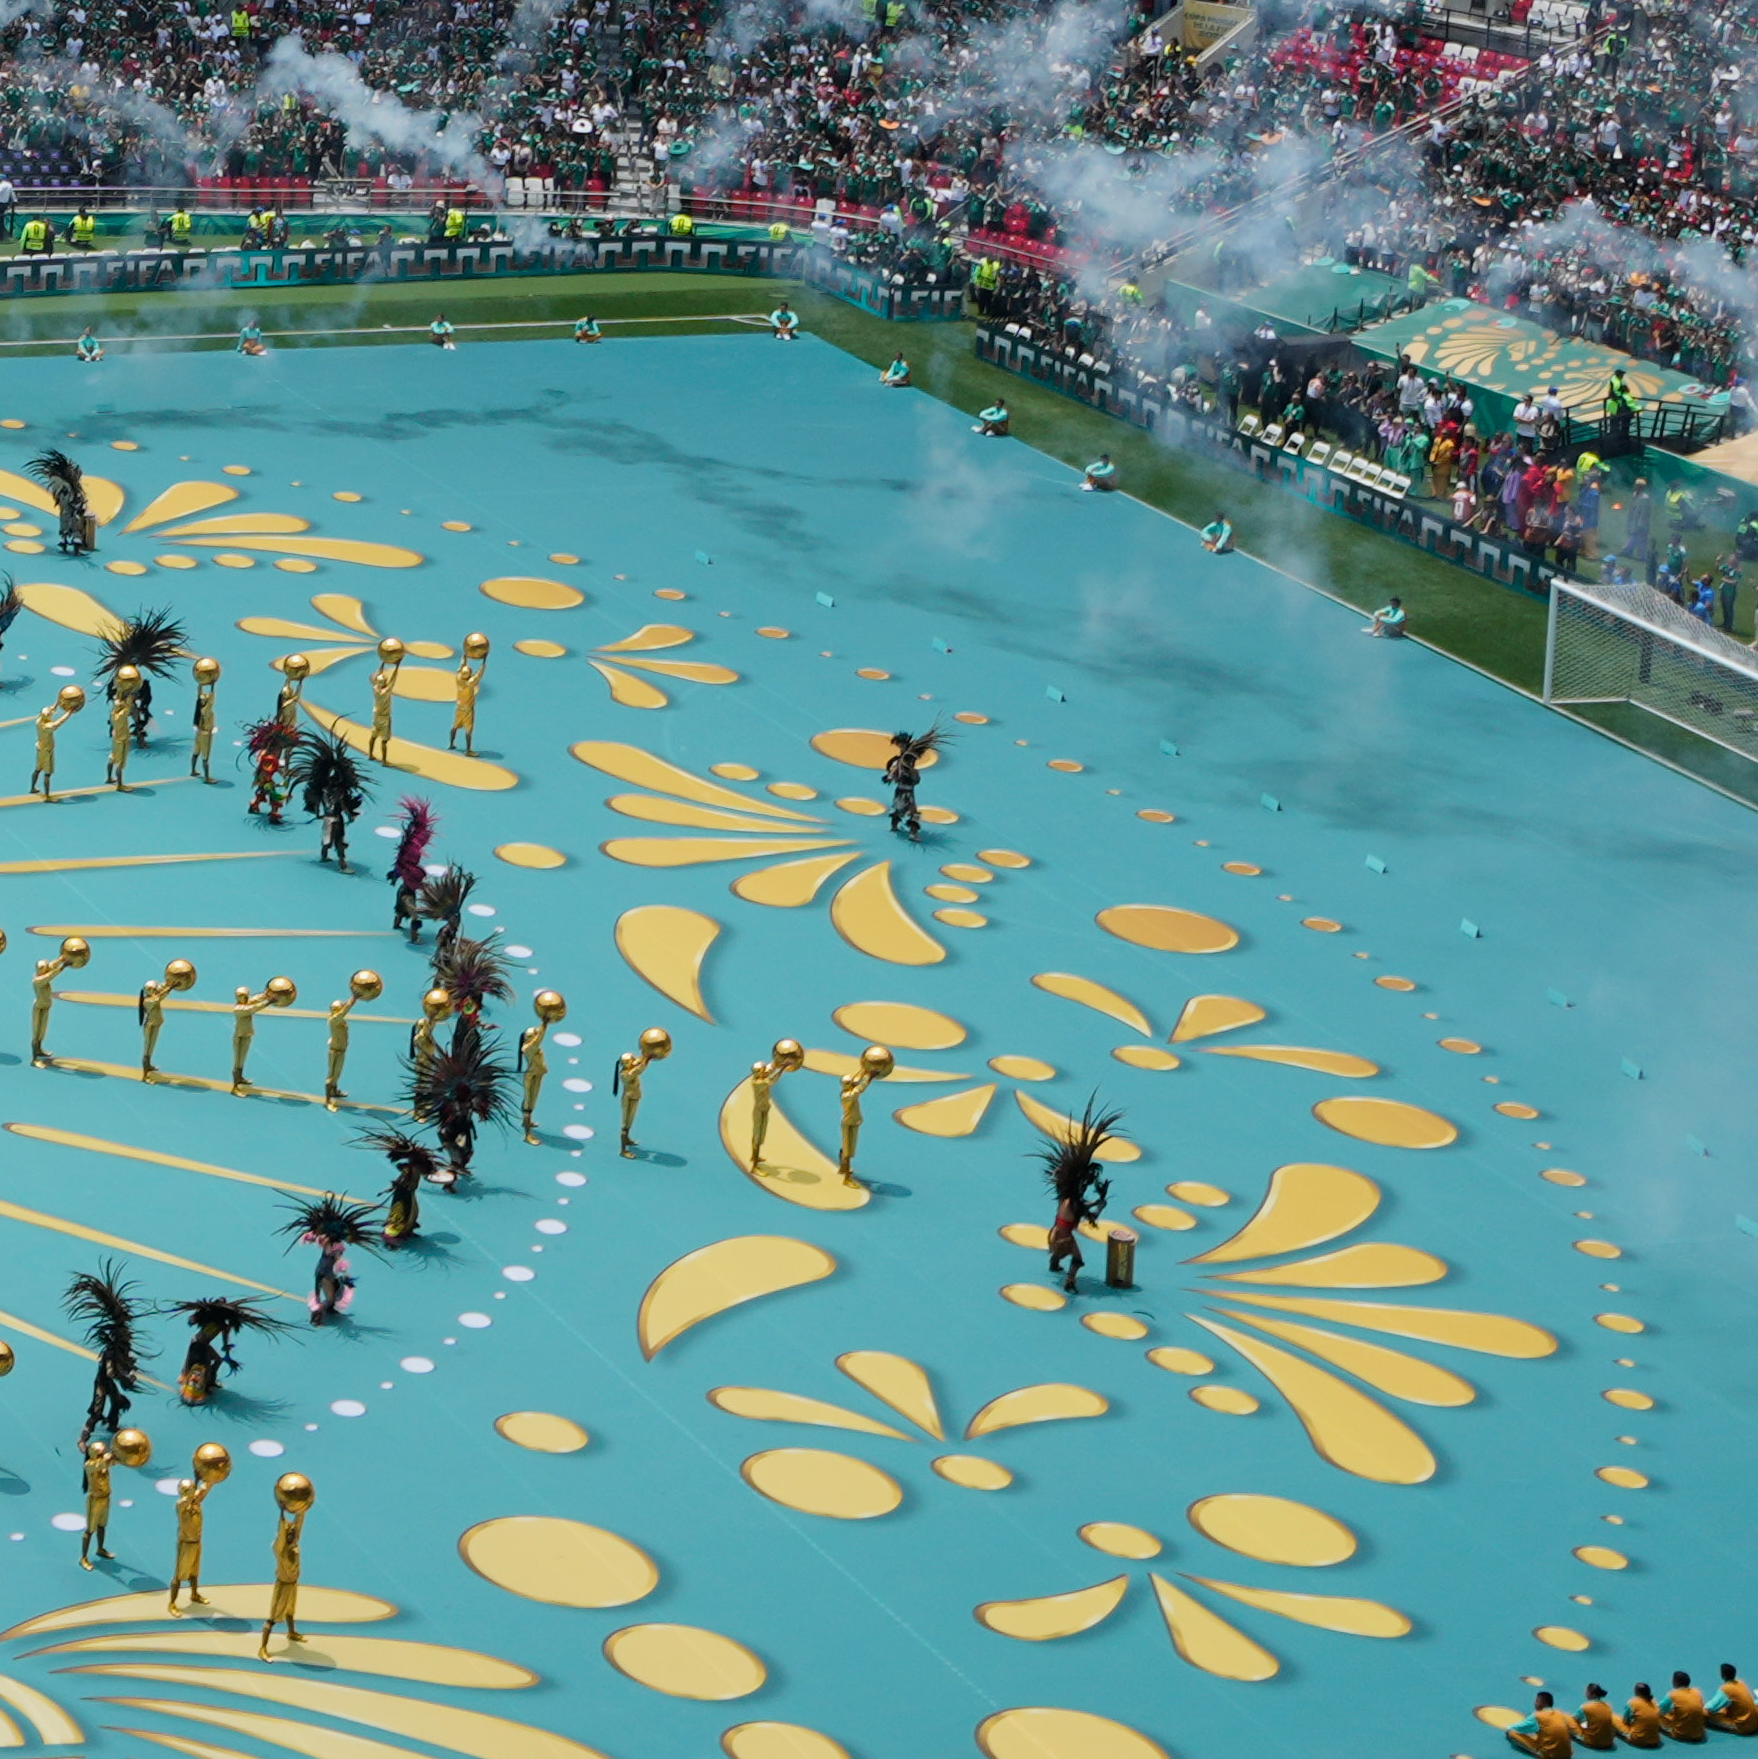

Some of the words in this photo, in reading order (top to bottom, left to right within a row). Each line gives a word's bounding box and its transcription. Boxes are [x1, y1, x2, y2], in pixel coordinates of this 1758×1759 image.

[107, 261, 178, 289] FIFA
[312, 252, 387, 281] FIFA
[1356, 489, 1420, 544] FIFA
